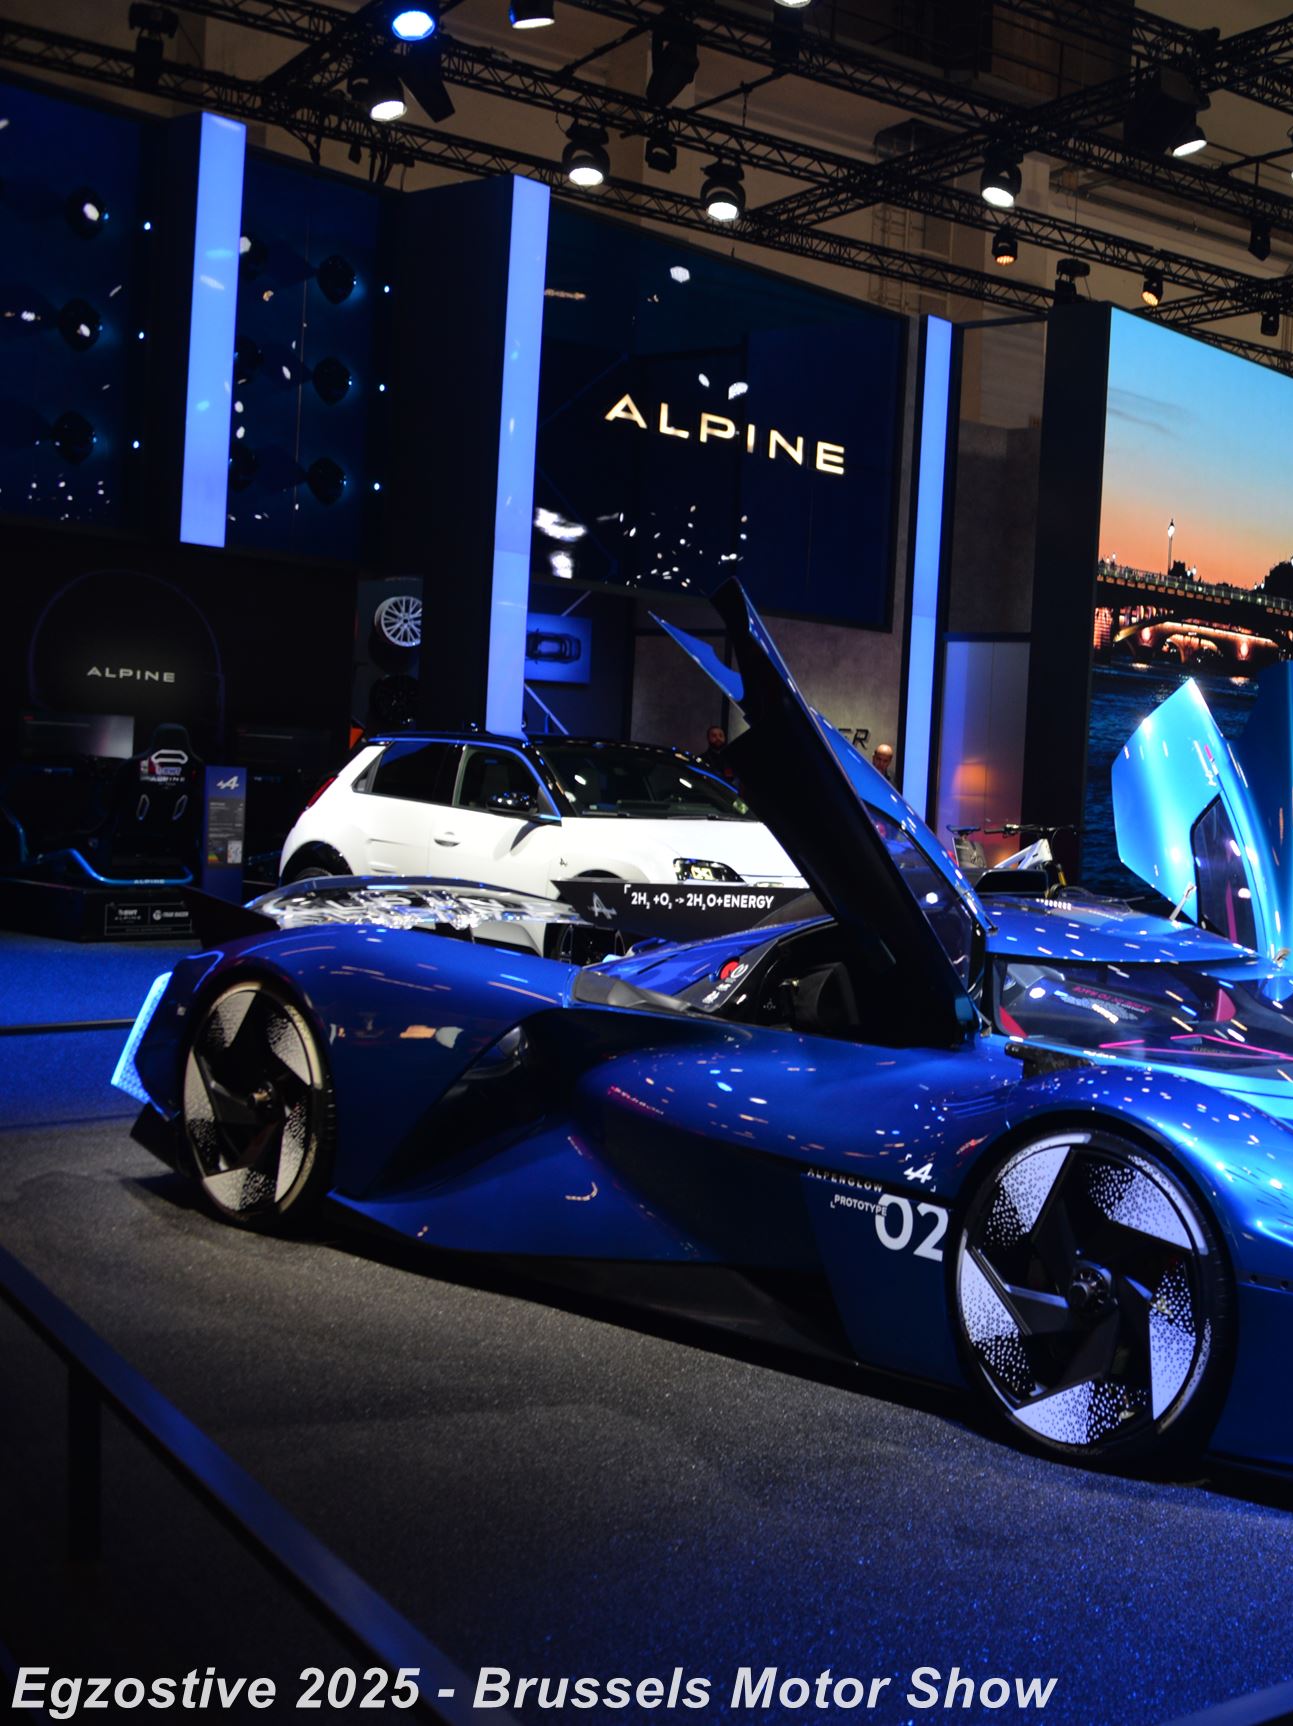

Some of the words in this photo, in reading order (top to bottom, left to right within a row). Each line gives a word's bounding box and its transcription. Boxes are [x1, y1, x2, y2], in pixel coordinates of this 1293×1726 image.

[604, 393, 844, 475] ALPINE
[86, 666, 176, 683] ALPINE
[807, 1168, 883, 1193] ALPENGLOW
[834, 1194, 888, 1217] PROTOTYPE
[875, 1193, 949, 1262] 02
